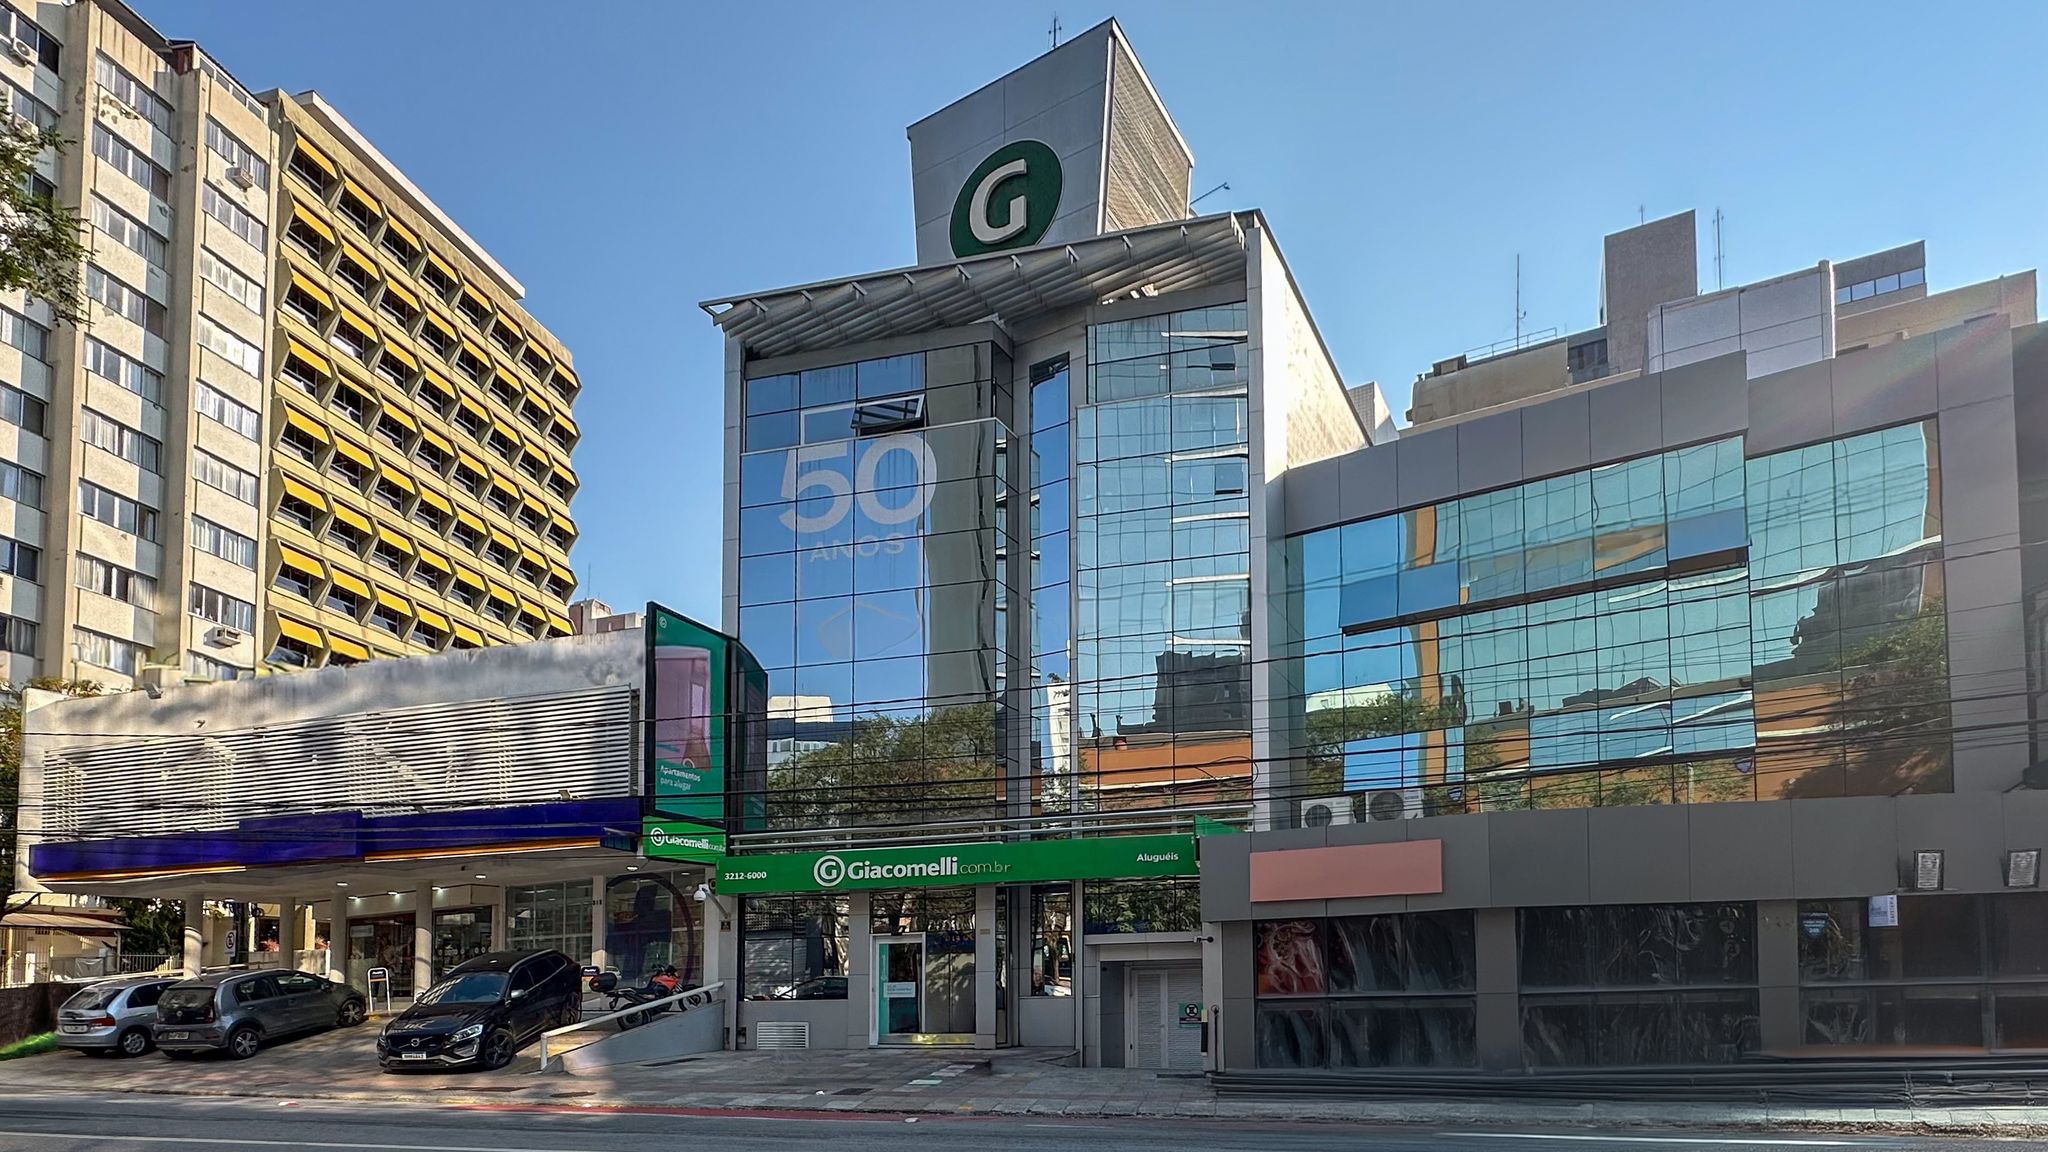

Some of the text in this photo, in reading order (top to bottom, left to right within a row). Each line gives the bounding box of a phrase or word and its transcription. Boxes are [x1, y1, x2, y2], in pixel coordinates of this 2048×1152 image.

[969, 158, 1027, 245] G
[778, 433, 938, 533] 50
[809, 532, 905, 563] ANOS
[1136, 852, 1179, 863] Aluguéis
[724, 871, 767, 880] 3212-6000
